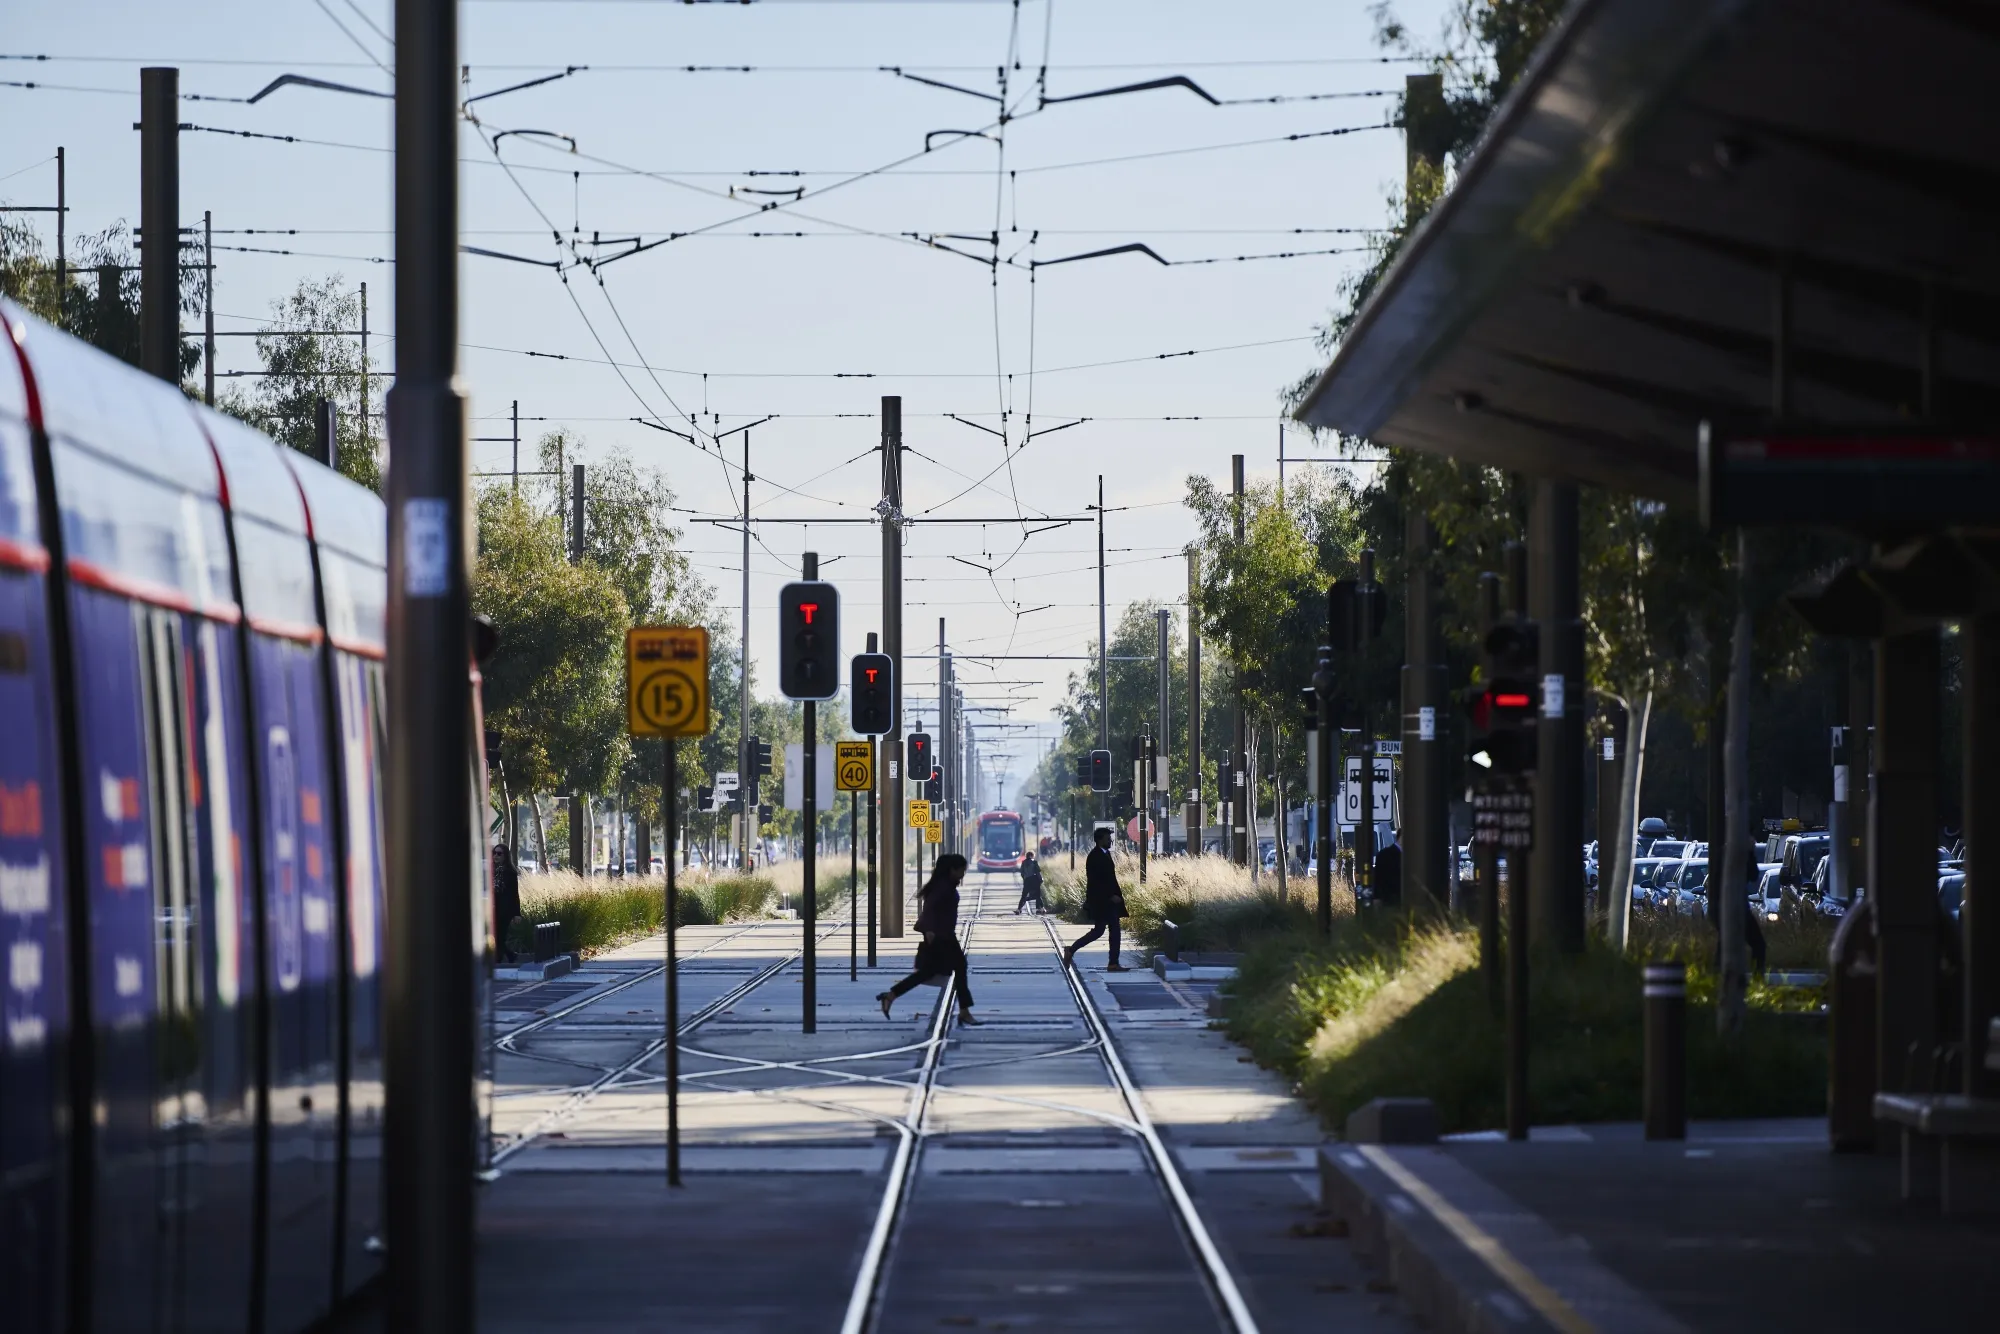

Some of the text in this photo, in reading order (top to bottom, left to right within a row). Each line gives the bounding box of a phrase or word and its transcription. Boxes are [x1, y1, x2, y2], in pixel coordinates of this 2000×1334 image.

[653, 684, 682, 717] 15
[1381, 743, 1402, 752] BUN
[845, 767, 864, 781] 40
[1350, 795, 1389, 809] OLY
[915, 814, 924, 822] 30
